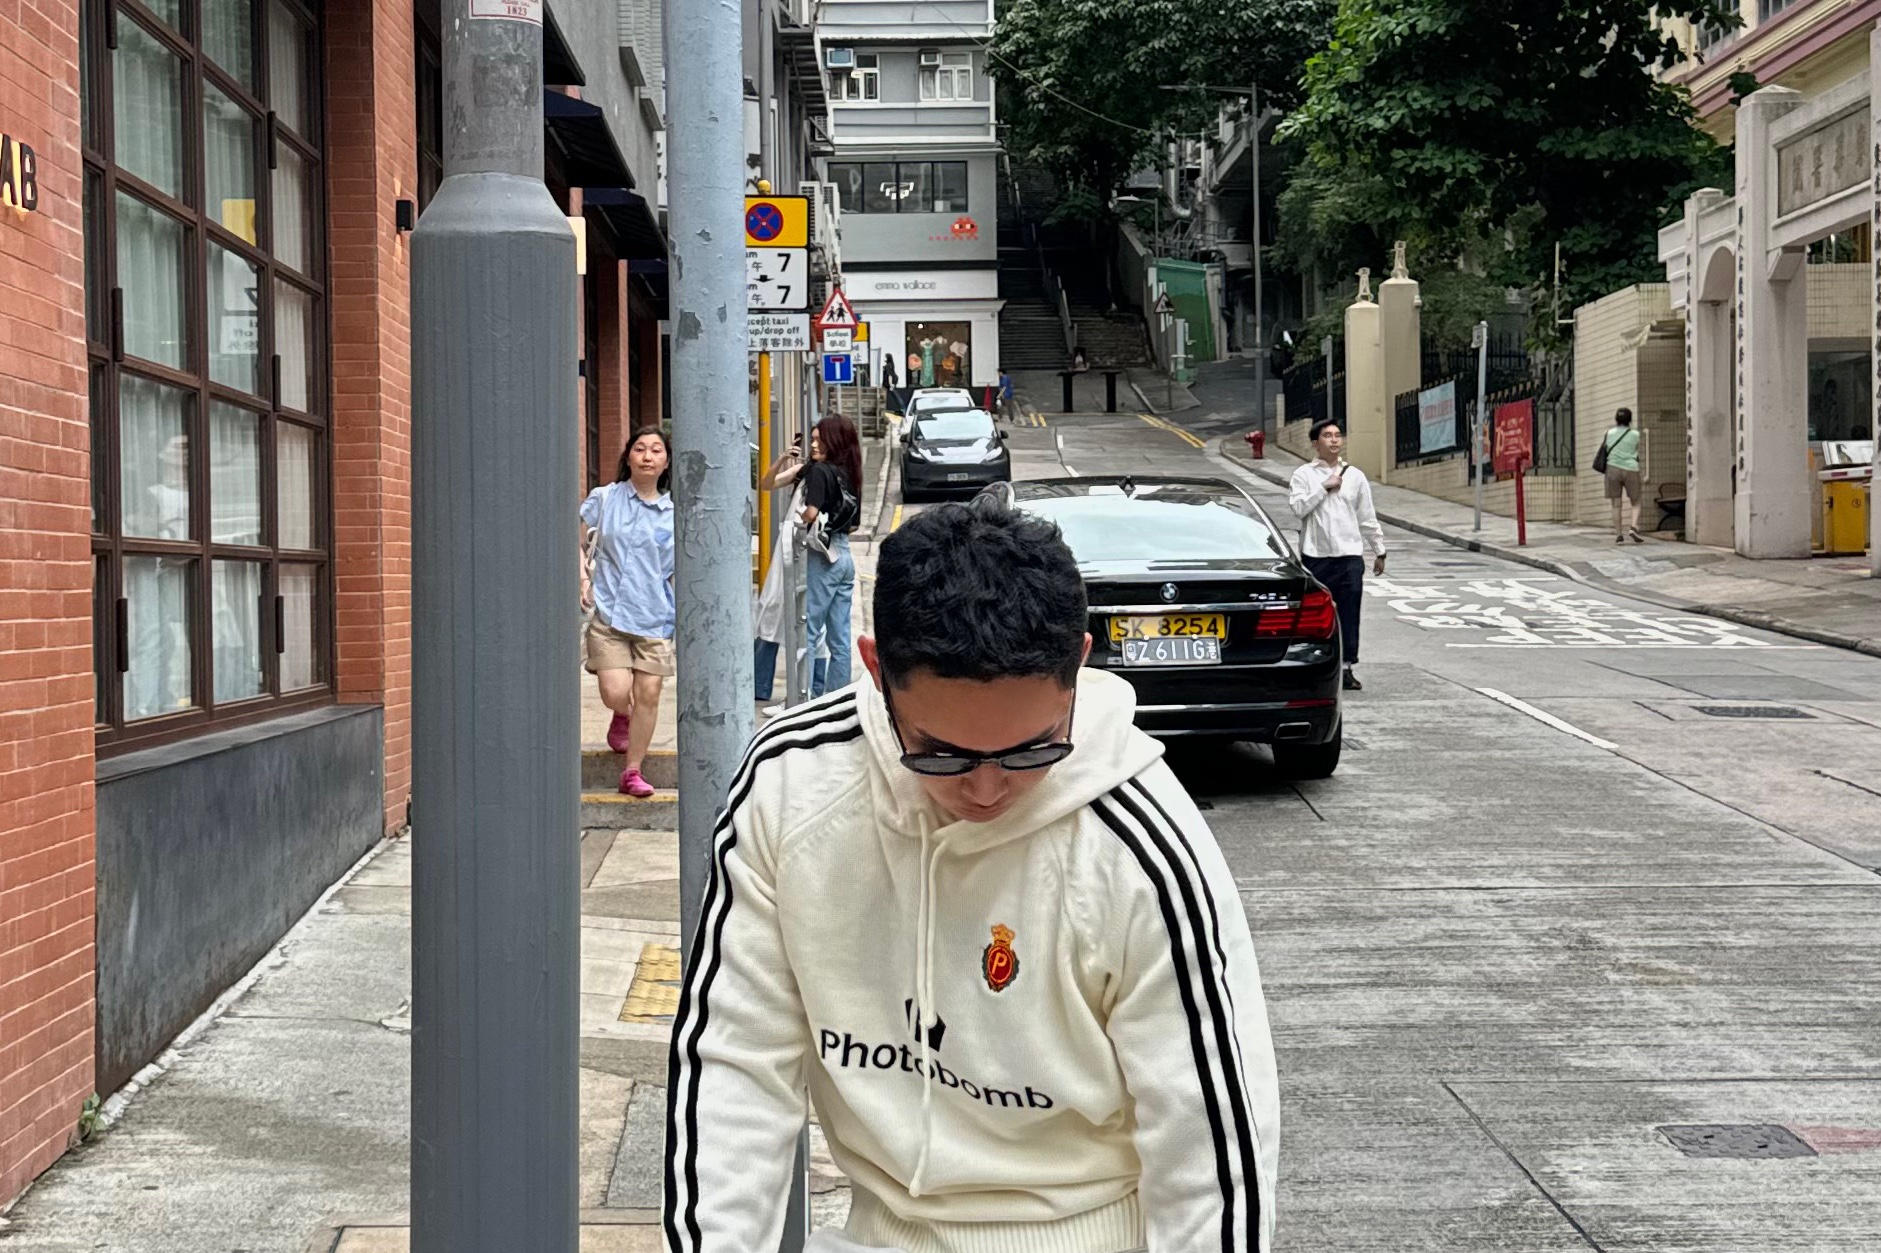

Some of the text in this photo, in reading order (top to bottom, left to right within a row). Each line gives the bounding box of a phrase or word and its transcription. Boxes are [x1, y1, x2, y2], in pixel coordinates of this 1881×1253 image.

[777, 252, 791, 272] 7
[776, 285, 791, 305] 7
[748, 316, 789, 326] cept taxi
[786, 326, 800, 334] off
[820, 1029, 1054, 1109] Photobomb
